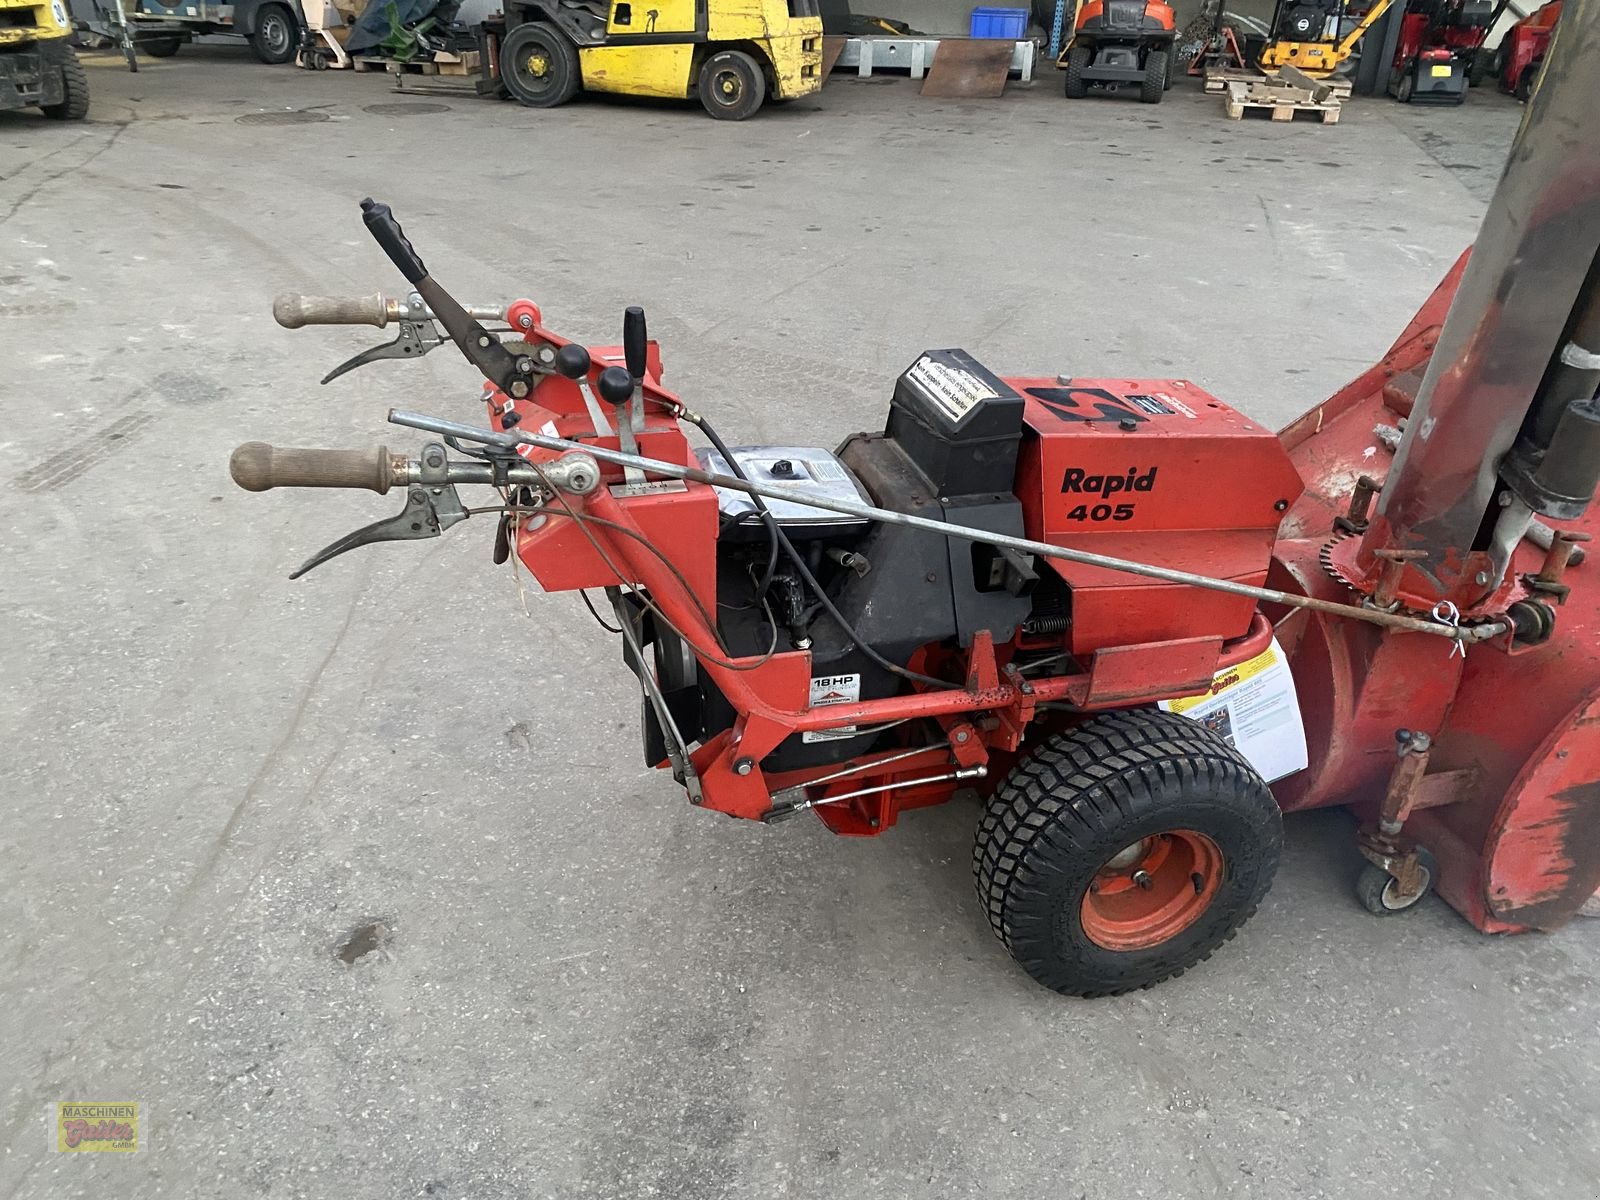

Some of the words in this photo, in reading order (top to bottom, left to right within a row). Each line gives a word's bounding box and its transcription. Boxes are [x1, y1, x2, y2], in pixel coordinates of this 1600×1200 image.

[1060, 466, 1158, 499] Rapid
[1066, 503, 1136, 522] 405
[814, 679, 830, 687] 18
[832, 677, 853, 686] HP
